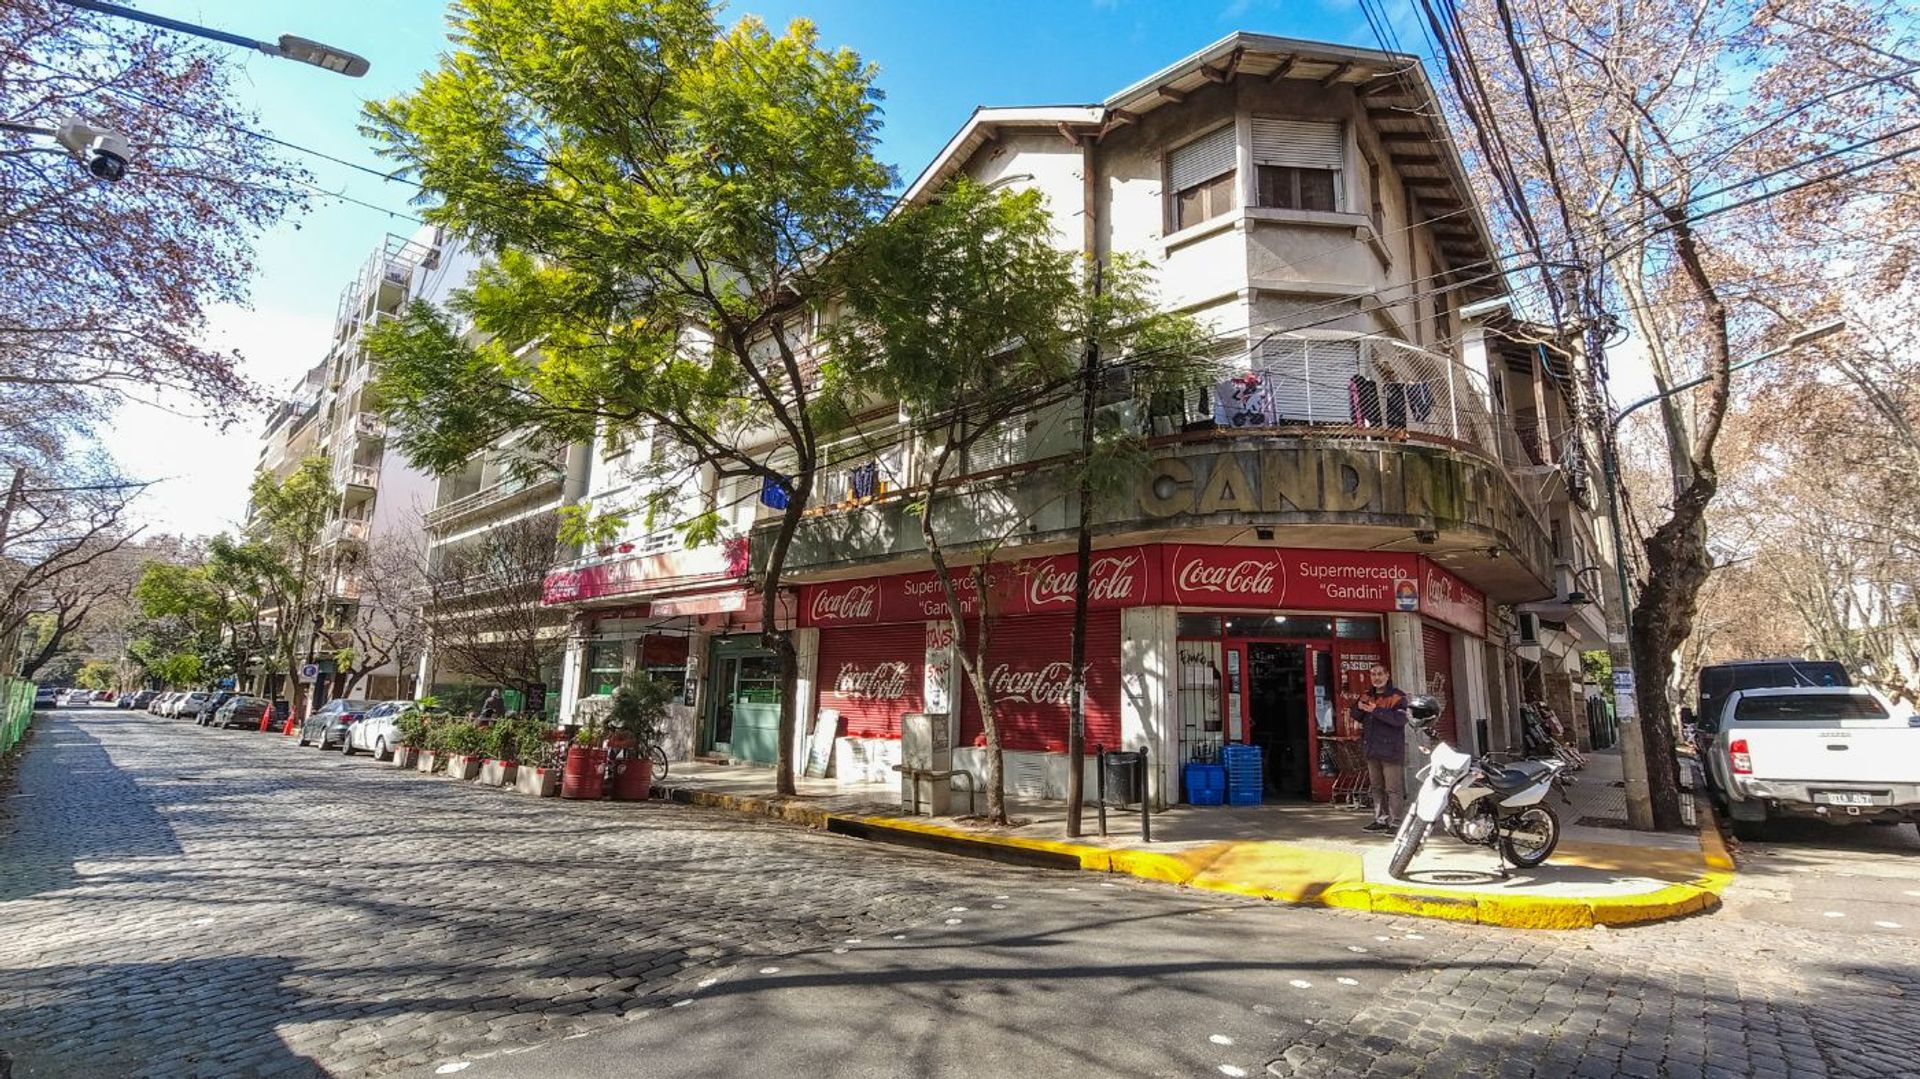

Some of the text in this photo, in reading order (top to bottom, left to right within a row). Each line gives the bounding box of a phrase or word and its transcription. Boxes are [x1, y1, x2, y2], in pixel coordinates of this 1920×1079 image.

[903, 575, 997, 597] Superercao
[1031, 553, 1140, 605] CocaCola
[1179, 558, 1279, 594] Coca-Cola
[1299, 562, 1407, 580] Supermercado
[811, 584, 877, 621] Coca-Cola
[919, 596, 978, 616] "Ganni"
[1319, 583, 1389, 600] "Gandini"
[834, 660, 910, 700] Coca-Cola
[988, 662, 1093, 704] Coca-Col
